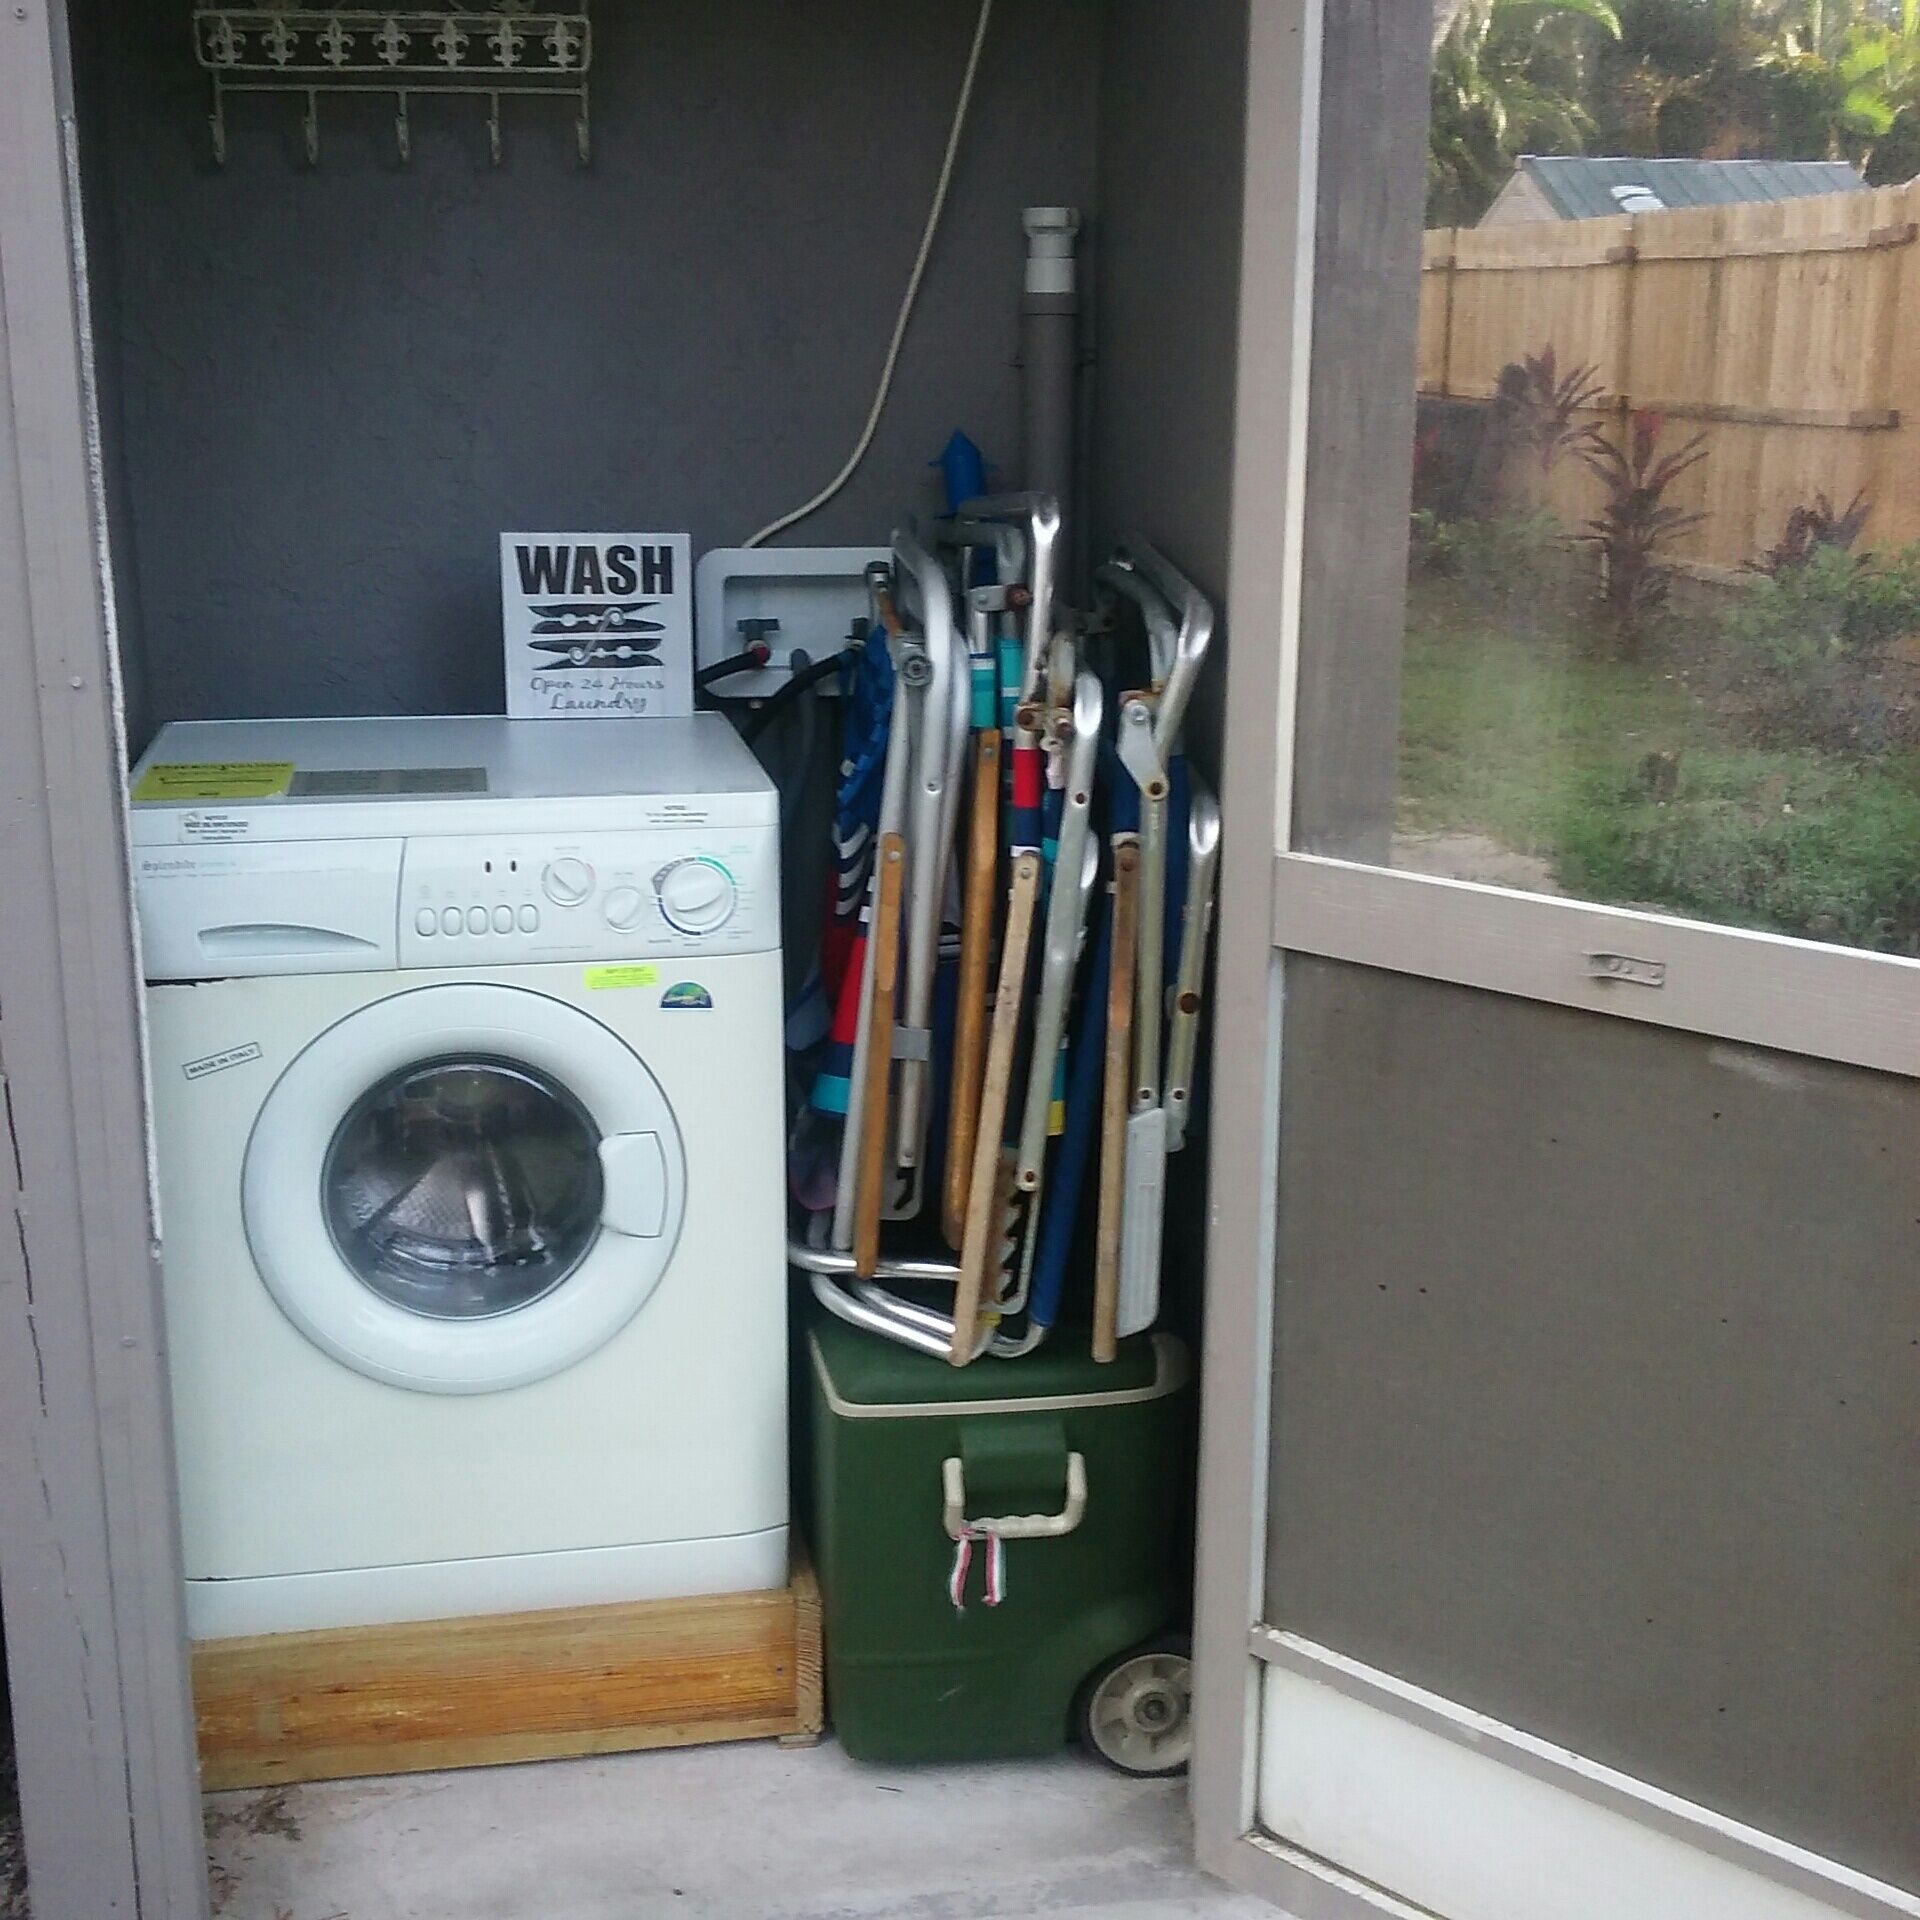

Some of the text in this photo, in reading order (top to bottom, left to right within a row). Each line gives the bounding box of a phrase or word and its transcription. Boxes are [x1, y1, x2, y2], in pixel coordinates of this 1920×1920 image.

[514, 544, 673, 595] WASH
[530, 676, 664, 694] Open 24 Hours
[550, 691, 647, 714] Laundry
[189, 1048, 256, 1074] MADE IN ITALY
